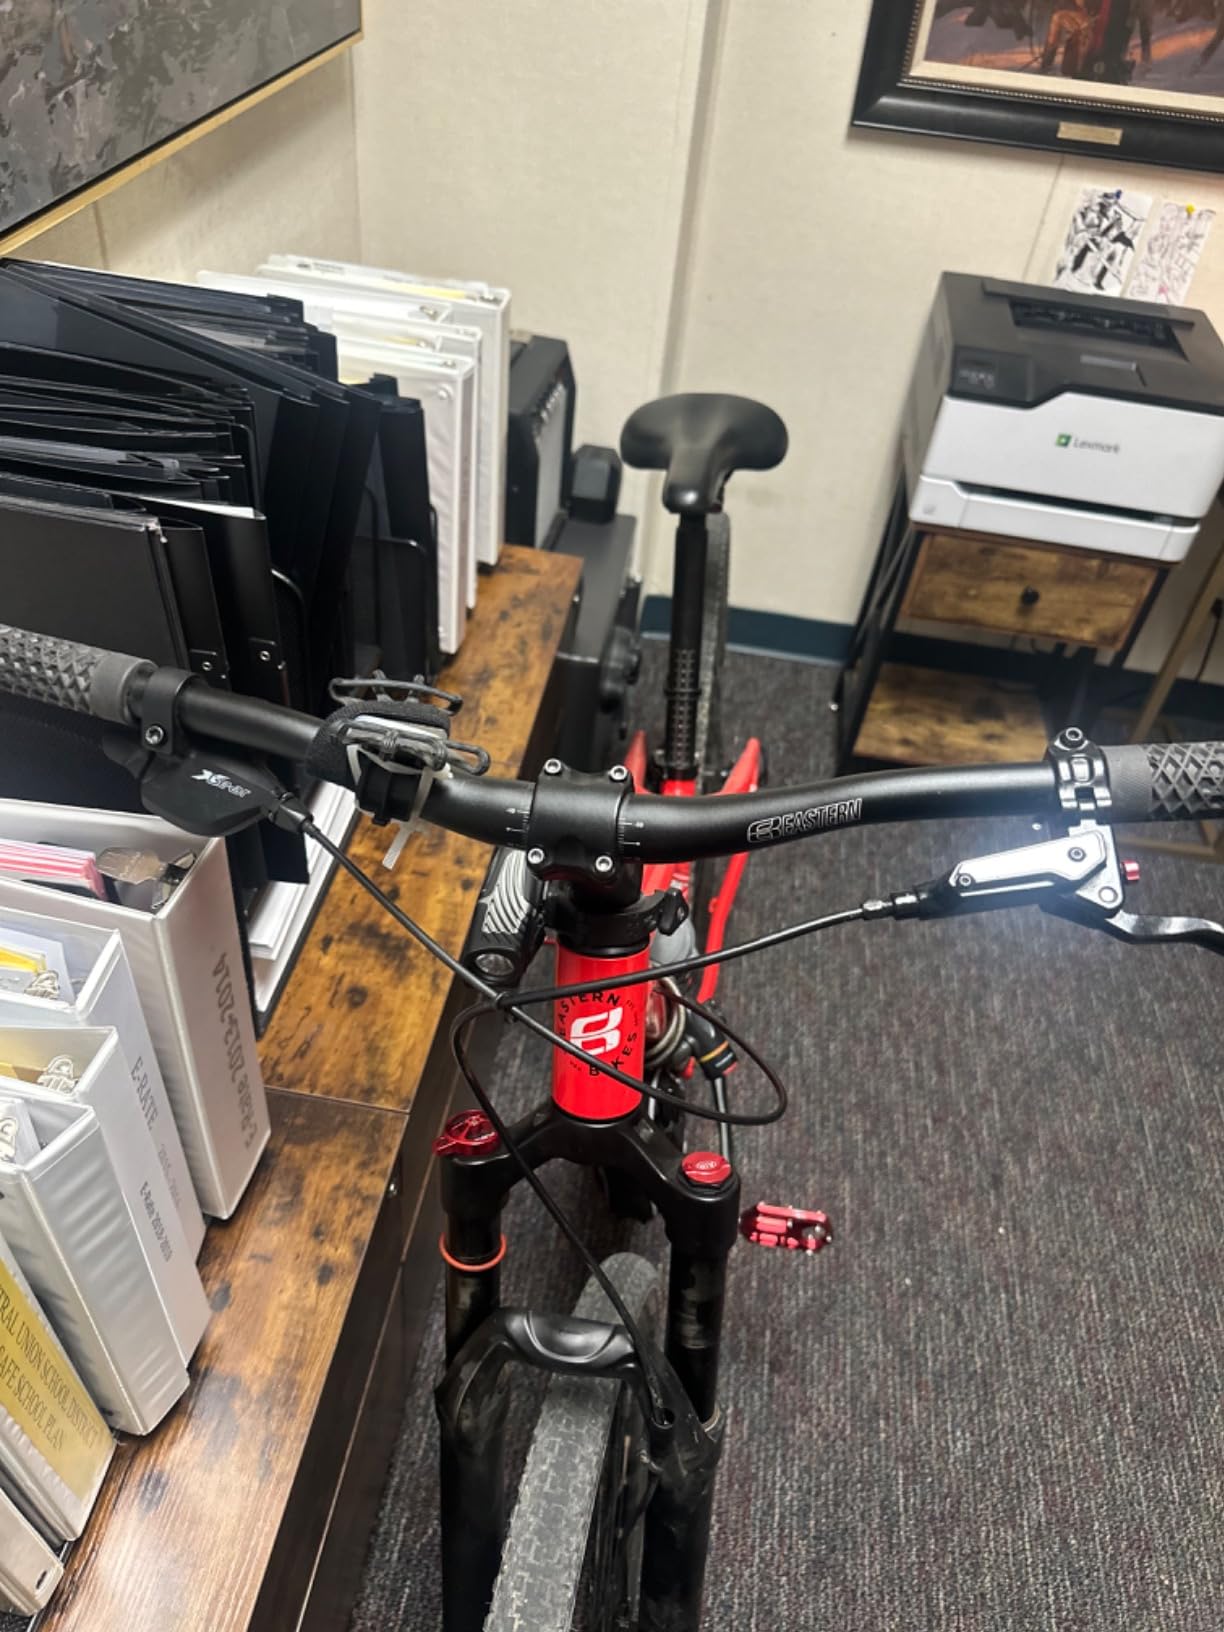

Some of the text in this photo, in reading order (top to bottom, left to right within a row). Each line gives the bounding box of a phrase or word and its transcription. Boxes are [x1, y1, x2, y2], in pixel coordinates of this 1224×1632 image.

[1073, 437, 1120, 454] Lexmark
[783, 798, 862, 837] EASTERN
[589, 1032, 637, 1076] BKES
[16, 1321, 46, 1372] UNION
[40, 1359, 72, 1411] SCHOOL
[65, 1396, 99, 1449] DISTRICT
[15, 1375, 48, 1428] SCHOOL
[42, 1414, 65, 1450] PLAN
